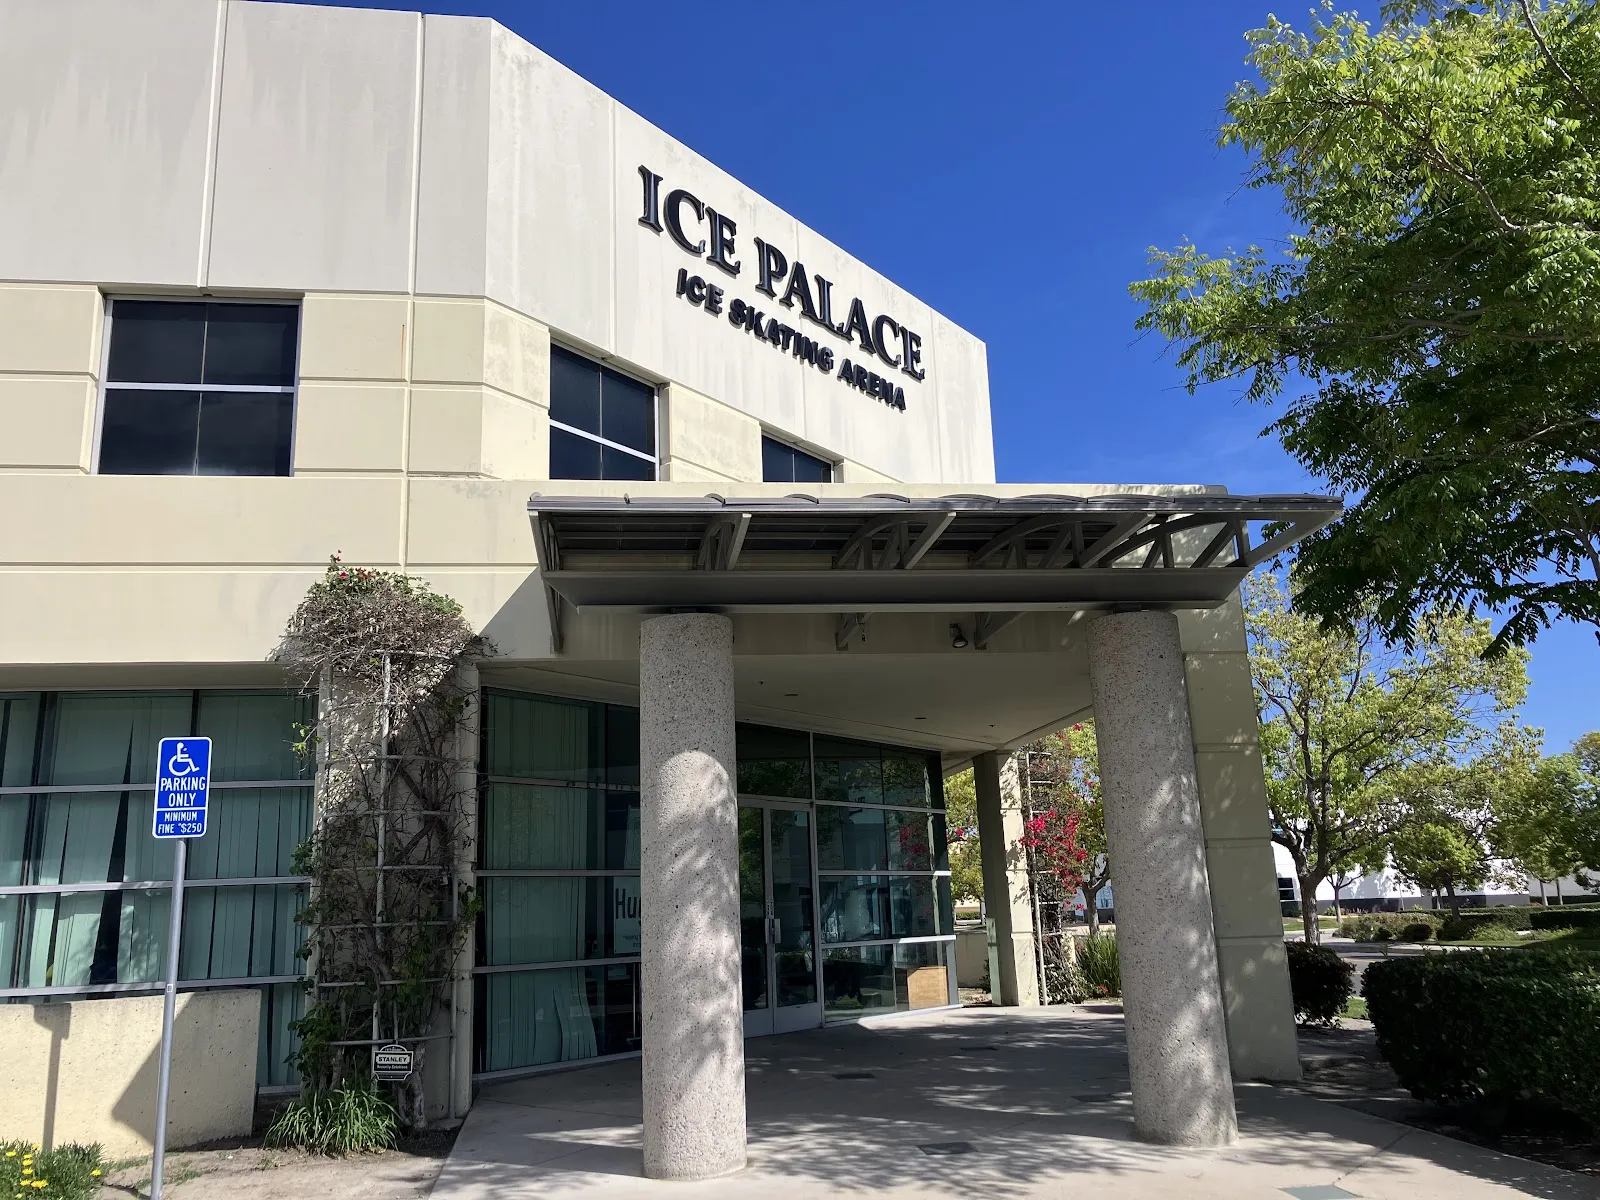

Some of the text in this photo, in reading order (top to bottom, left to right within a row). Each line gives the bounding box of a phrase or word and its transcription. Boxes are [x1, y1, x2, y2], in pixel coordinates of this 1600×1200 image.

[638, 164, 925, 383] ICE PALACE
[676, 267, 906, 413] ICE SKATING ARENA
[160, 777, 206, 791] PARKING
[168, 793, 196, 807] ONLY
[164, 811, 198, 822] MINIMUM
[158, 823, 175, 834] FINE
[615, 888, 641, 920] Hu
